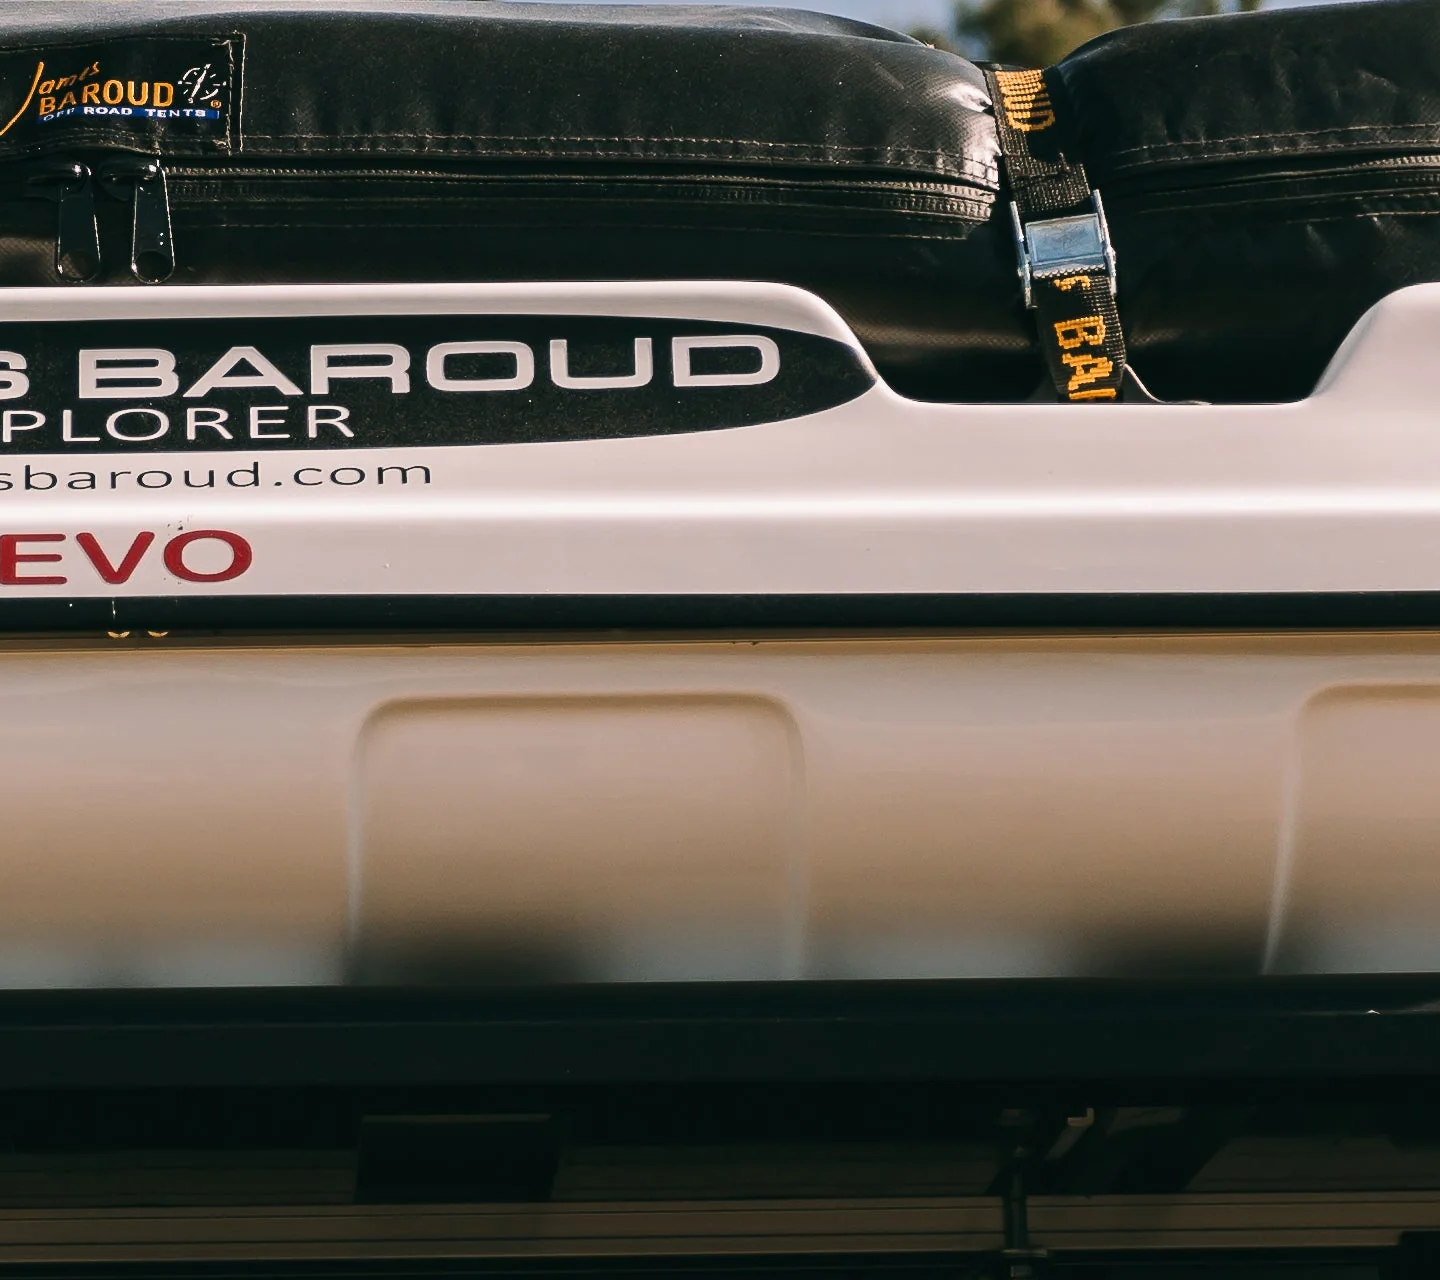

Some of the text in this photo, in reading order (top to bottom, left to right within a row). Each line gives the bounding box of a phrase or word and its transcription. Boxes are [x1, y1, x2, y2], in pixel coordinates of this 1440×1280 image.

[39, 79, 174, 116] BAROUD
[83, 106, 133, 116] ROAD
[145, 108, 206, 118] TENTS
[78, 334, 781, 399] BAROUD
